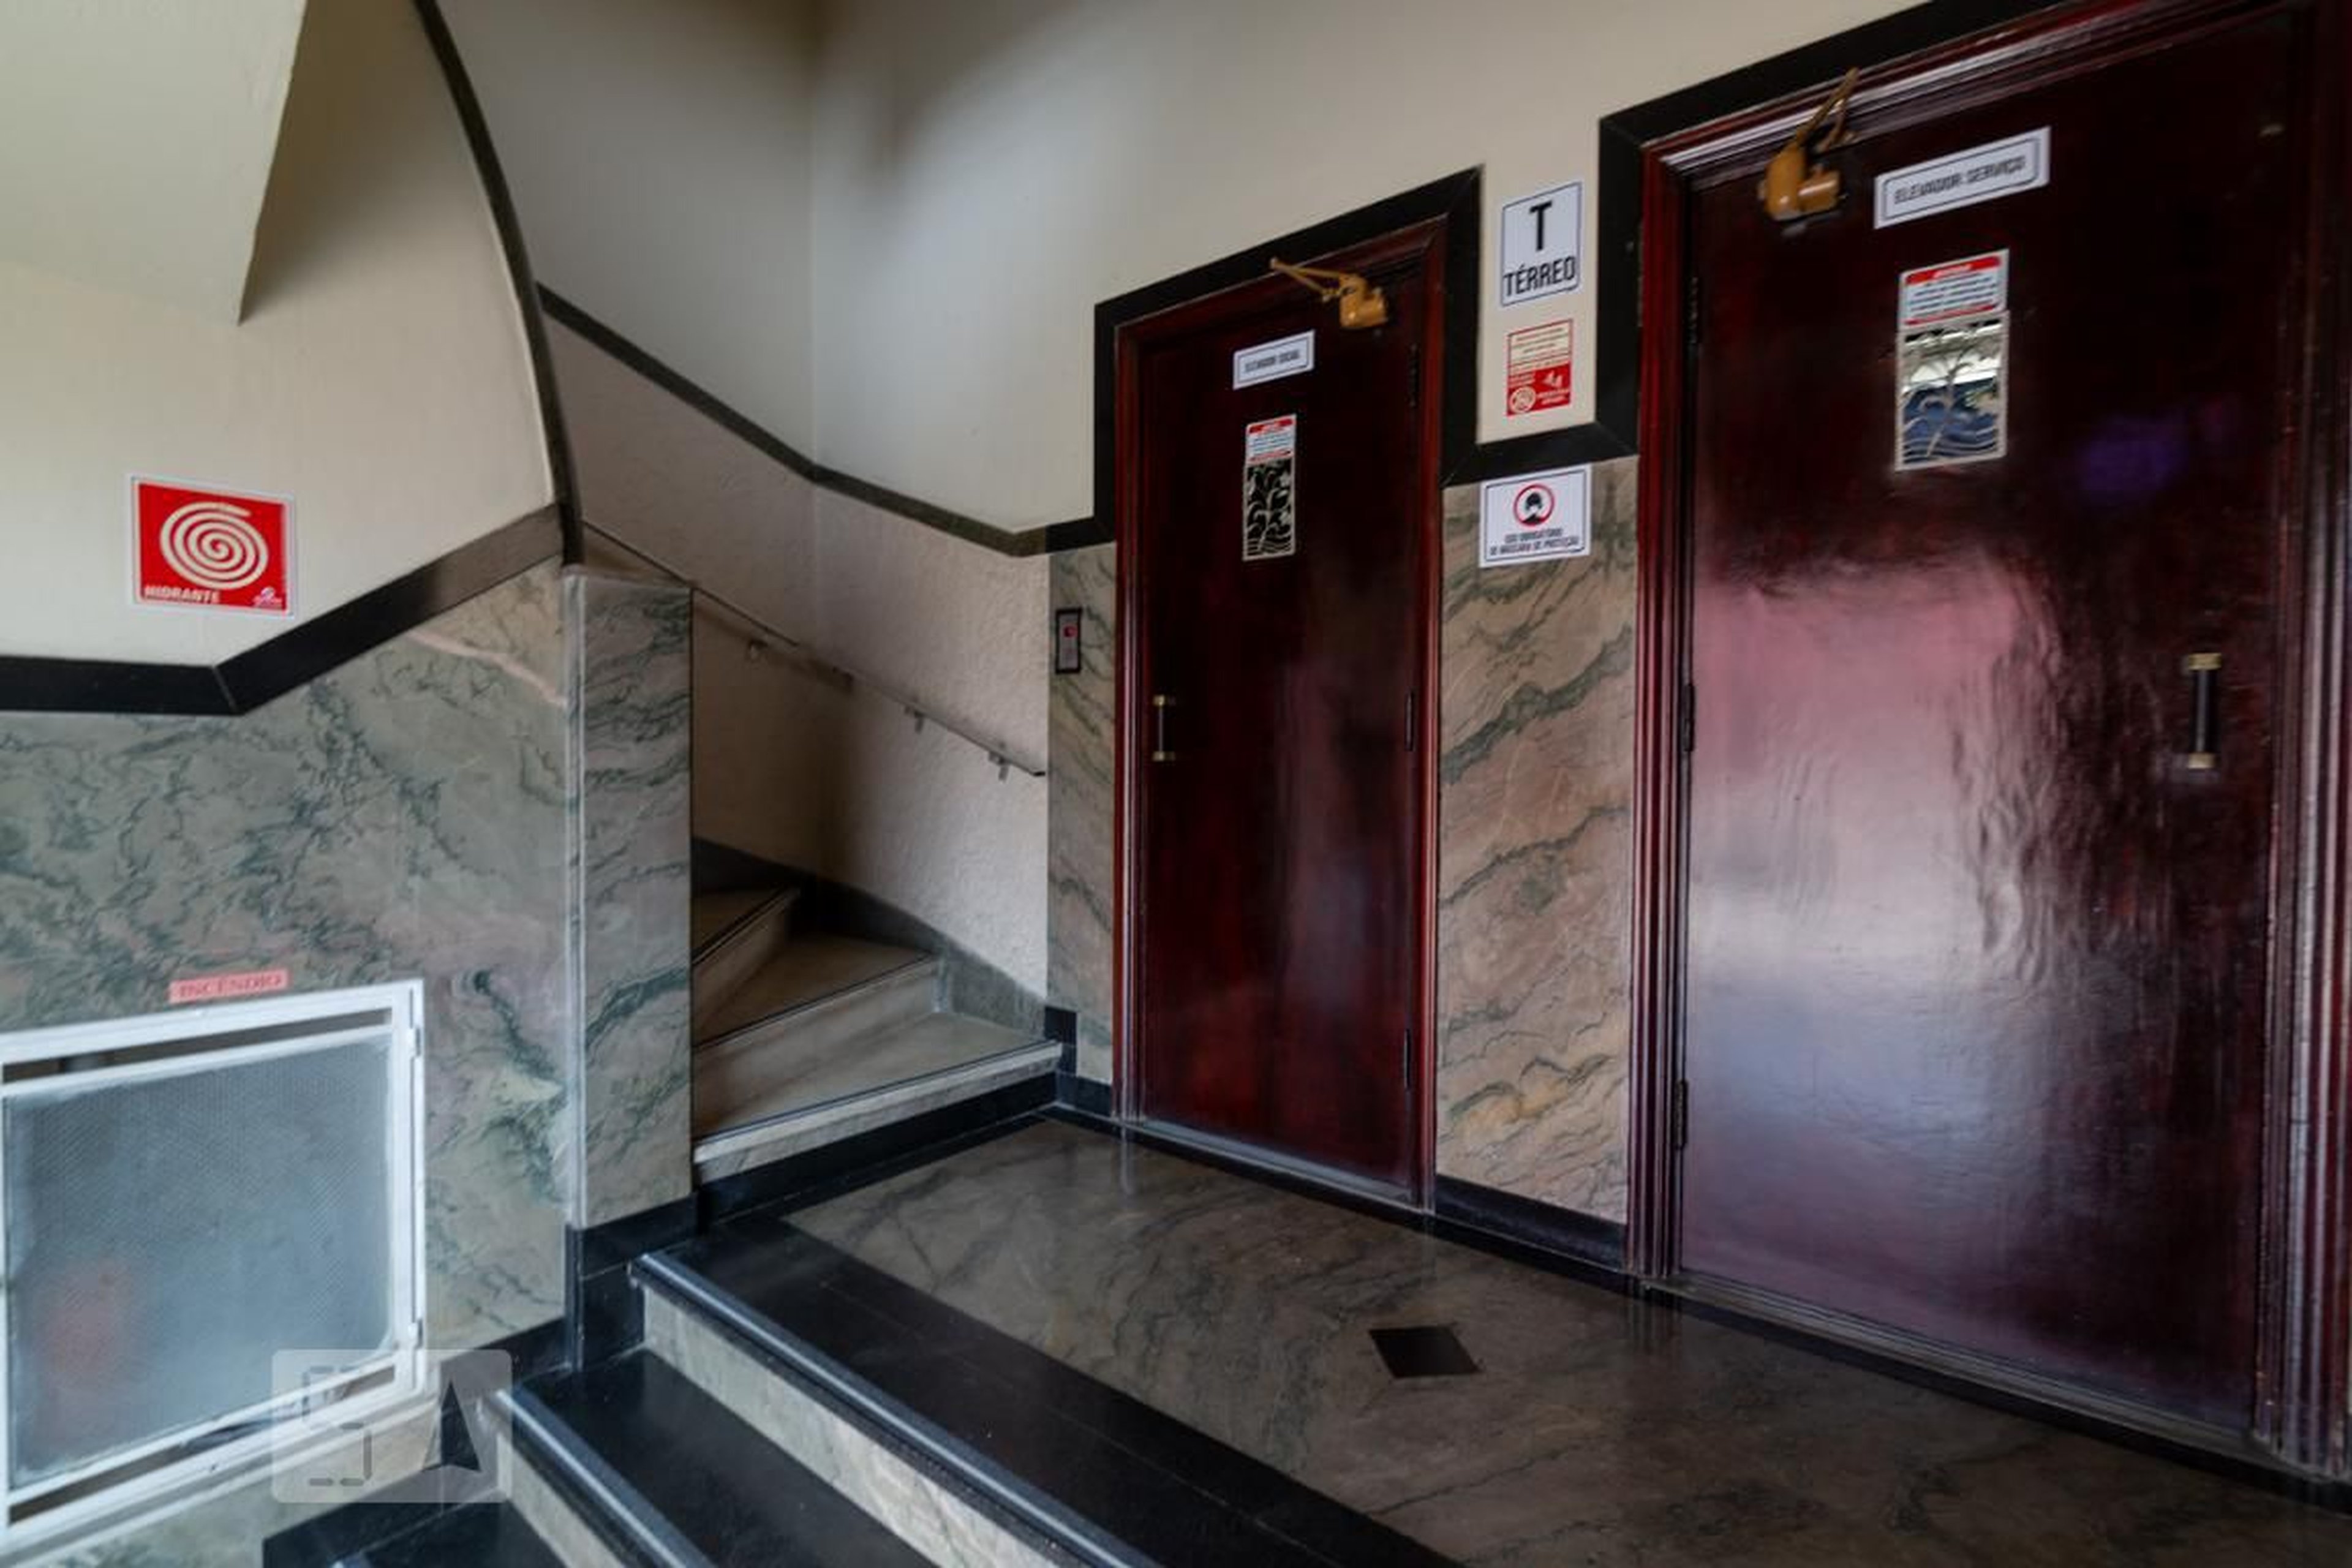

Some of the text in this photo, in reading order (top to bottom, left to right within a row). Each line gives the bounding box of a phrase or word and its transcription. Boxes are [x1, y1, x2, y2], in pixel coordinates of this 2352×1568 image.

[1894, 155, 2026, 205] ELEVADOR SERVIÇO
[1529, 200, 1553, 251] T
[1503, 256, 1576, 297] TÉRREO
[144, 585, 221, 605] HIDRANTE
